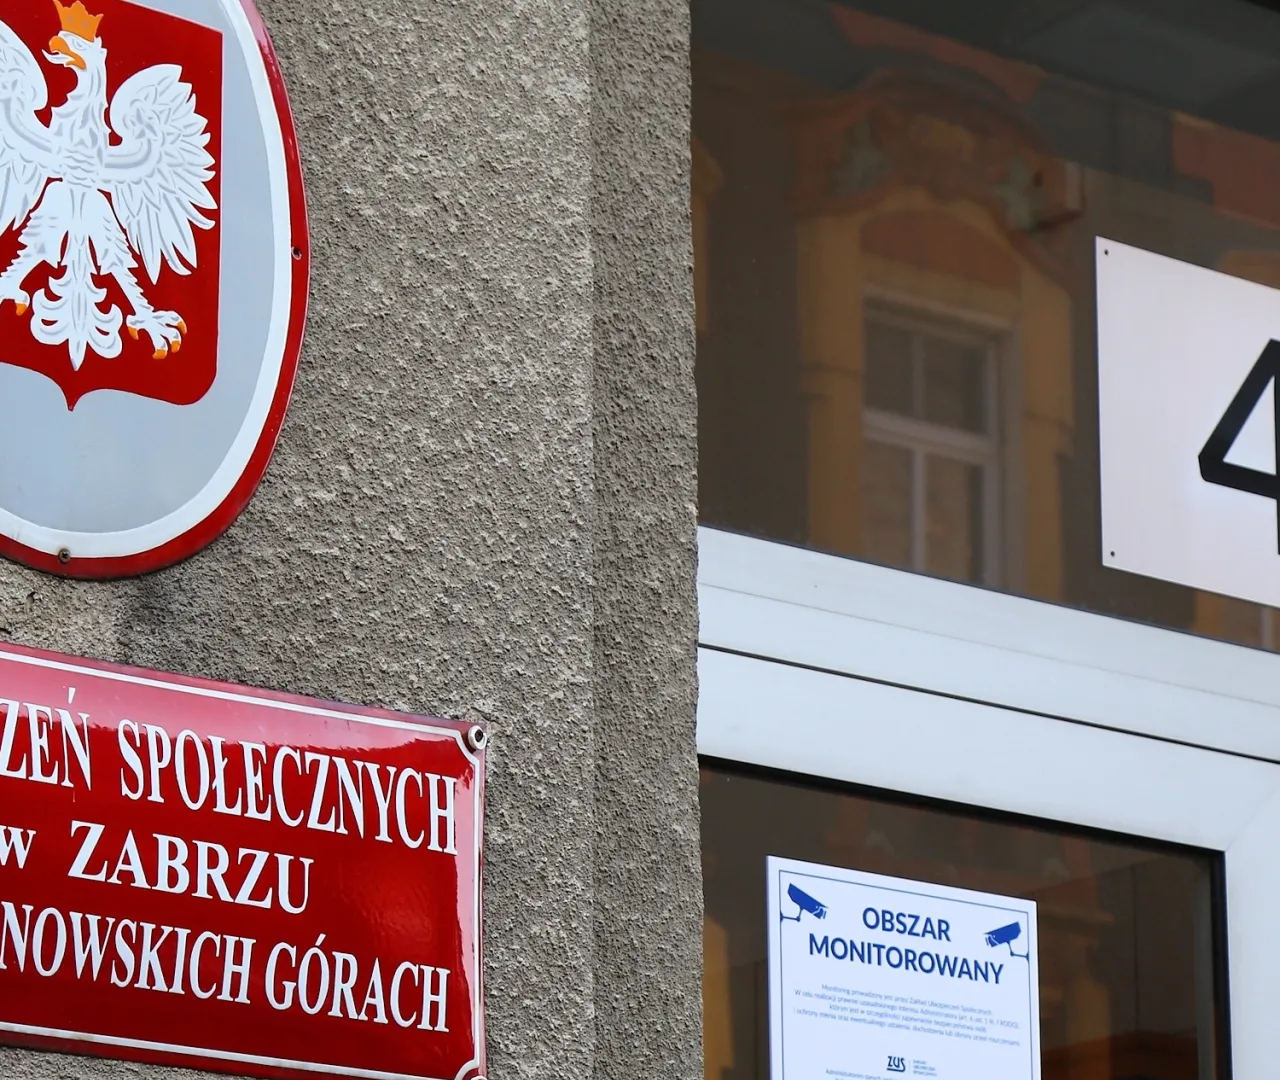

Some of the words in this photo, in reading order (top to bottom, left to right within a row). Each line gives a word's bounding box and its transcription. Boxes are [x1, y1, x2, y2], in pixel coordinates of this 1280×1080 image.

[117, 718, 458, 855] SPOŁECZNYCH
[68, 820, 313, 914] ZABRZU
[808, 932, 1005, 985] MONITOROWANY
[862, 906, 952, 942] OBSZAR
[265, 933, 450, 1033] GÓRACH
[886, 1055, 906, 1073] ZUS
